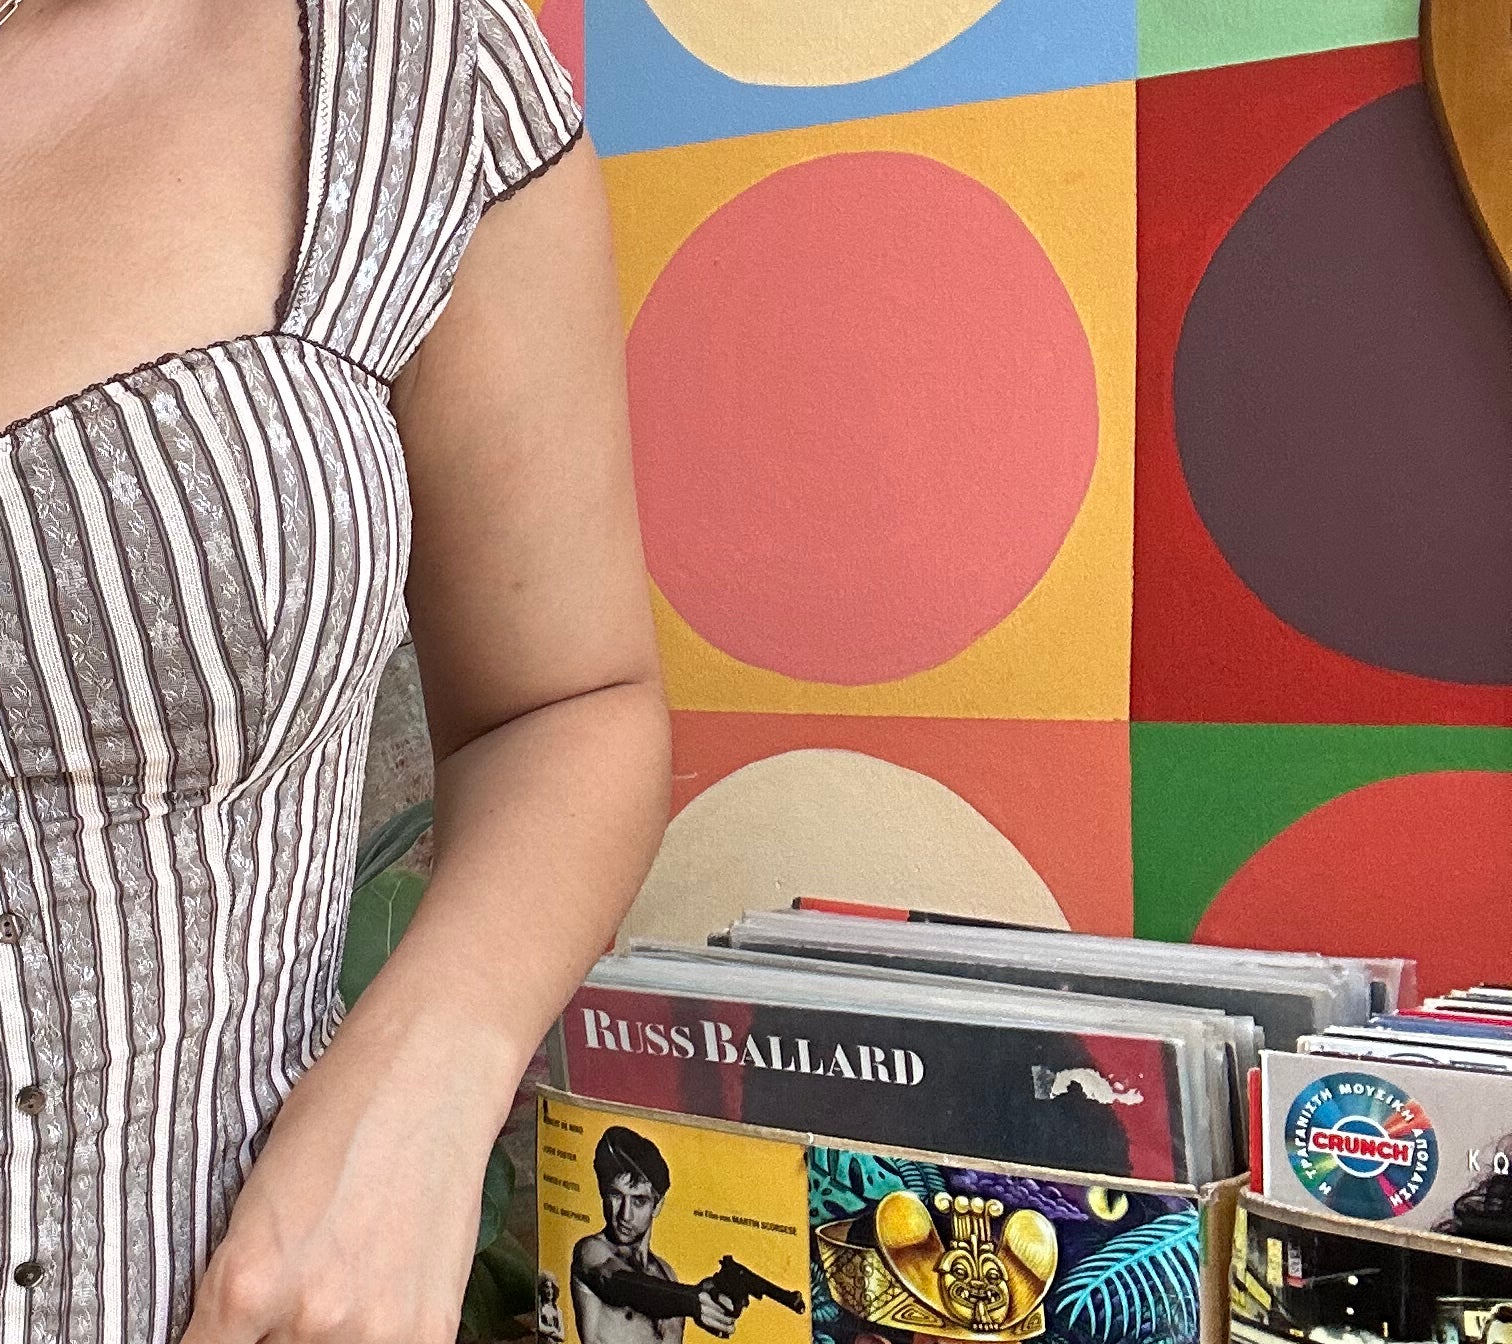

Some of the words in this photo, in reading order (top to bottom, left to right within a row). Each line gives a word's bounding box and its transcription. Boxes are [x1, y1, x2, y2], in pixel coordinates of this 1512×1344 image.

[582, 1007, 694, 1059] RUSS
[700, 1019, 926, 1086] BALLARD
[1312, 1131, 1409, 1163] CRUNCH
